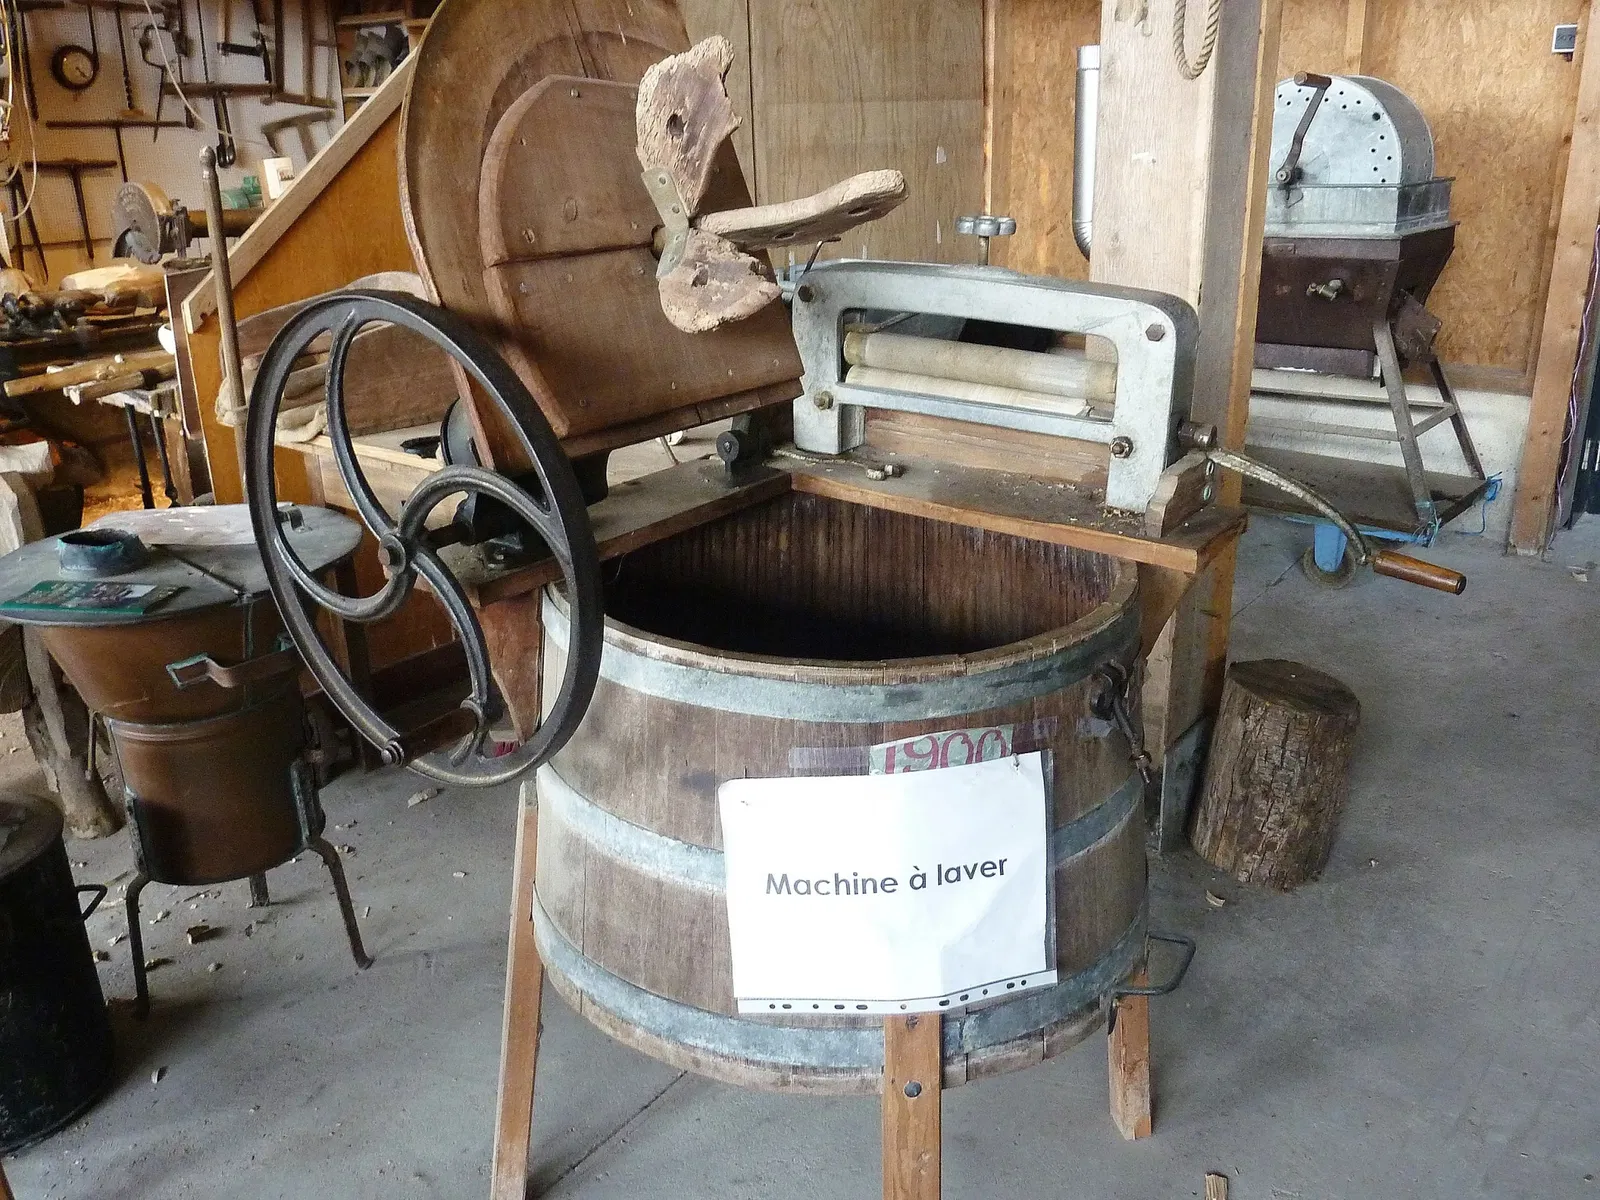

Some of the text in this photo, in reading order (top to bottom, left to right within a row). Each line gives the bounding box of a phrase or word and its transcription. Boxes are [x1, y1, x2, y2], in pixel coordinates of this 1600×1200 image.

[885, 729, 1007, 774] 1900
[766, 858, 1008, 896] Machine à laver
